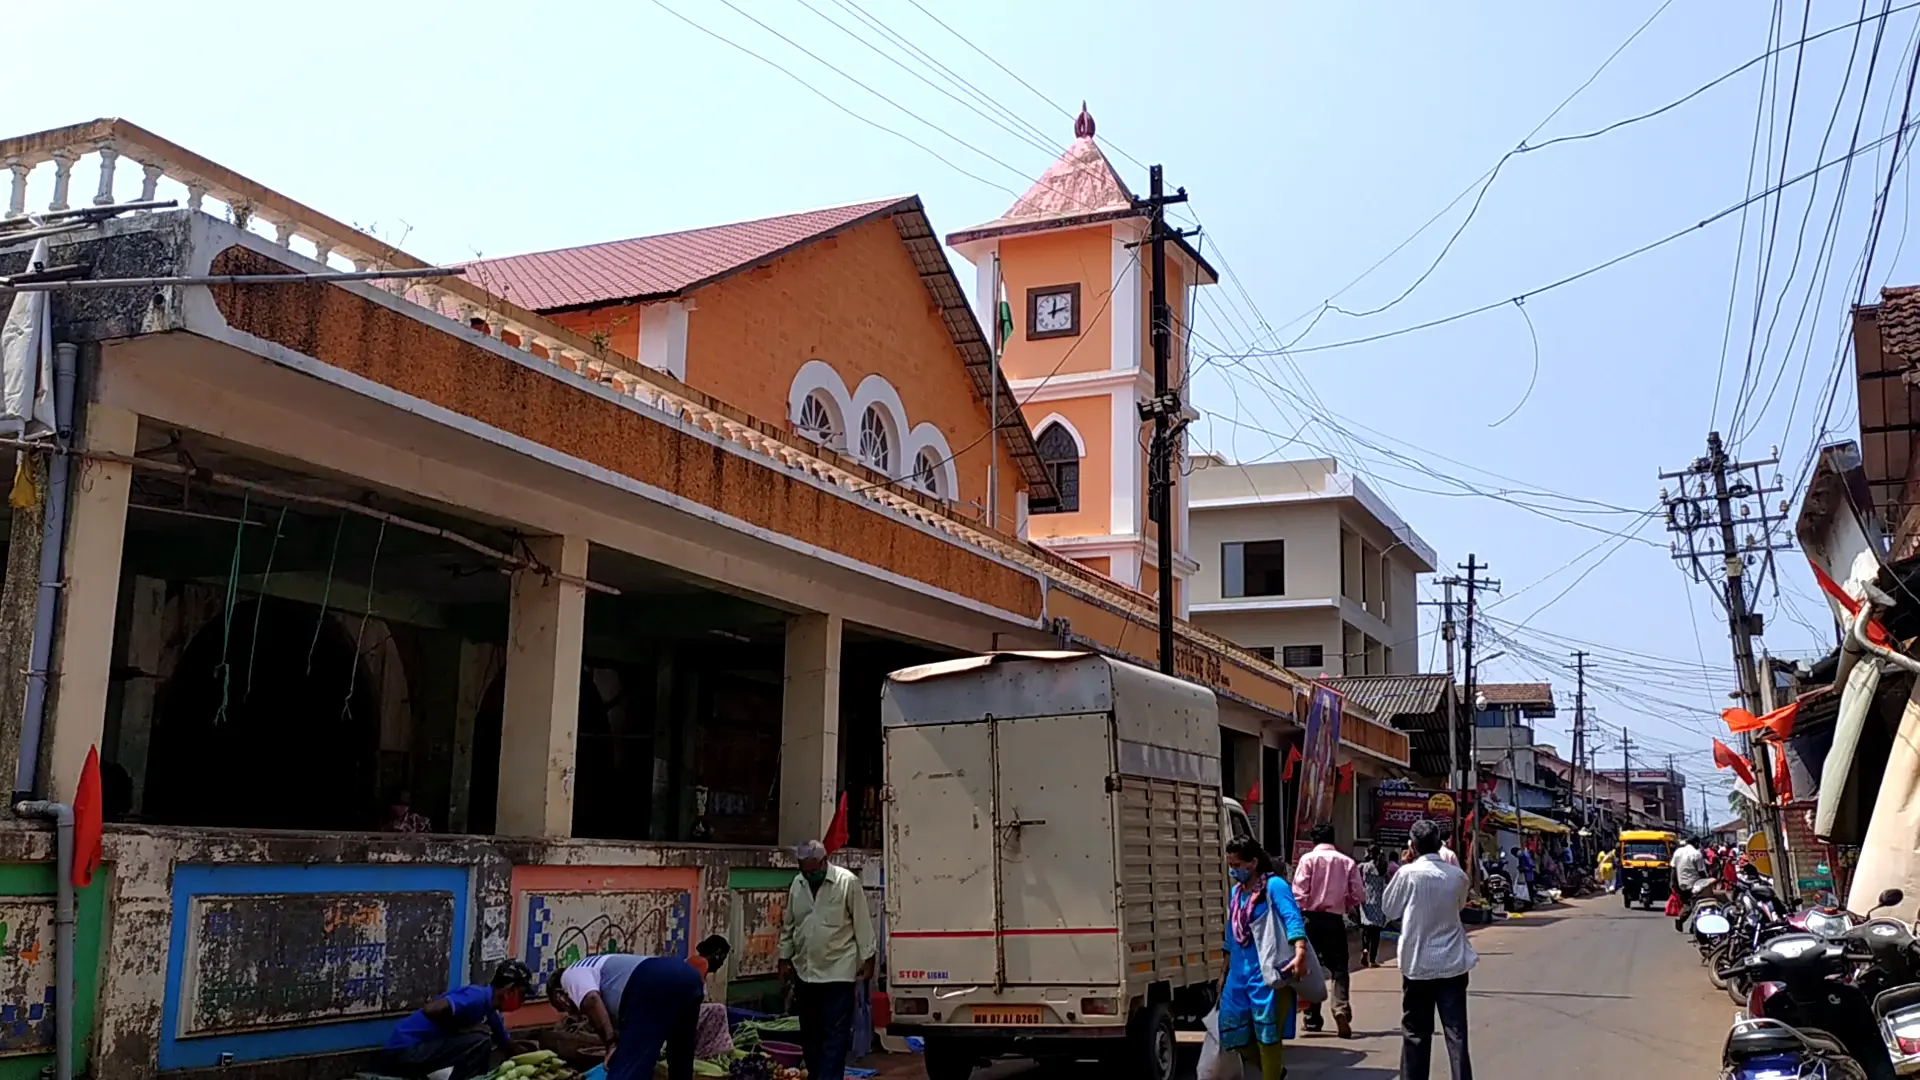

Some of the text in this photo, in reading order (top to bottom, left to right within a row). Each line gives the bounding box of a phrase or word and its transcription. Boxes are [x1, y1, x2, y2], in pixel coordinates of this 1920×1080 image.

[899, 970, 949, 980] STOP SIGNAL
[990, 1013, 1001, 1024] 07
[1015, 1013, 1039, 1024] 0269
